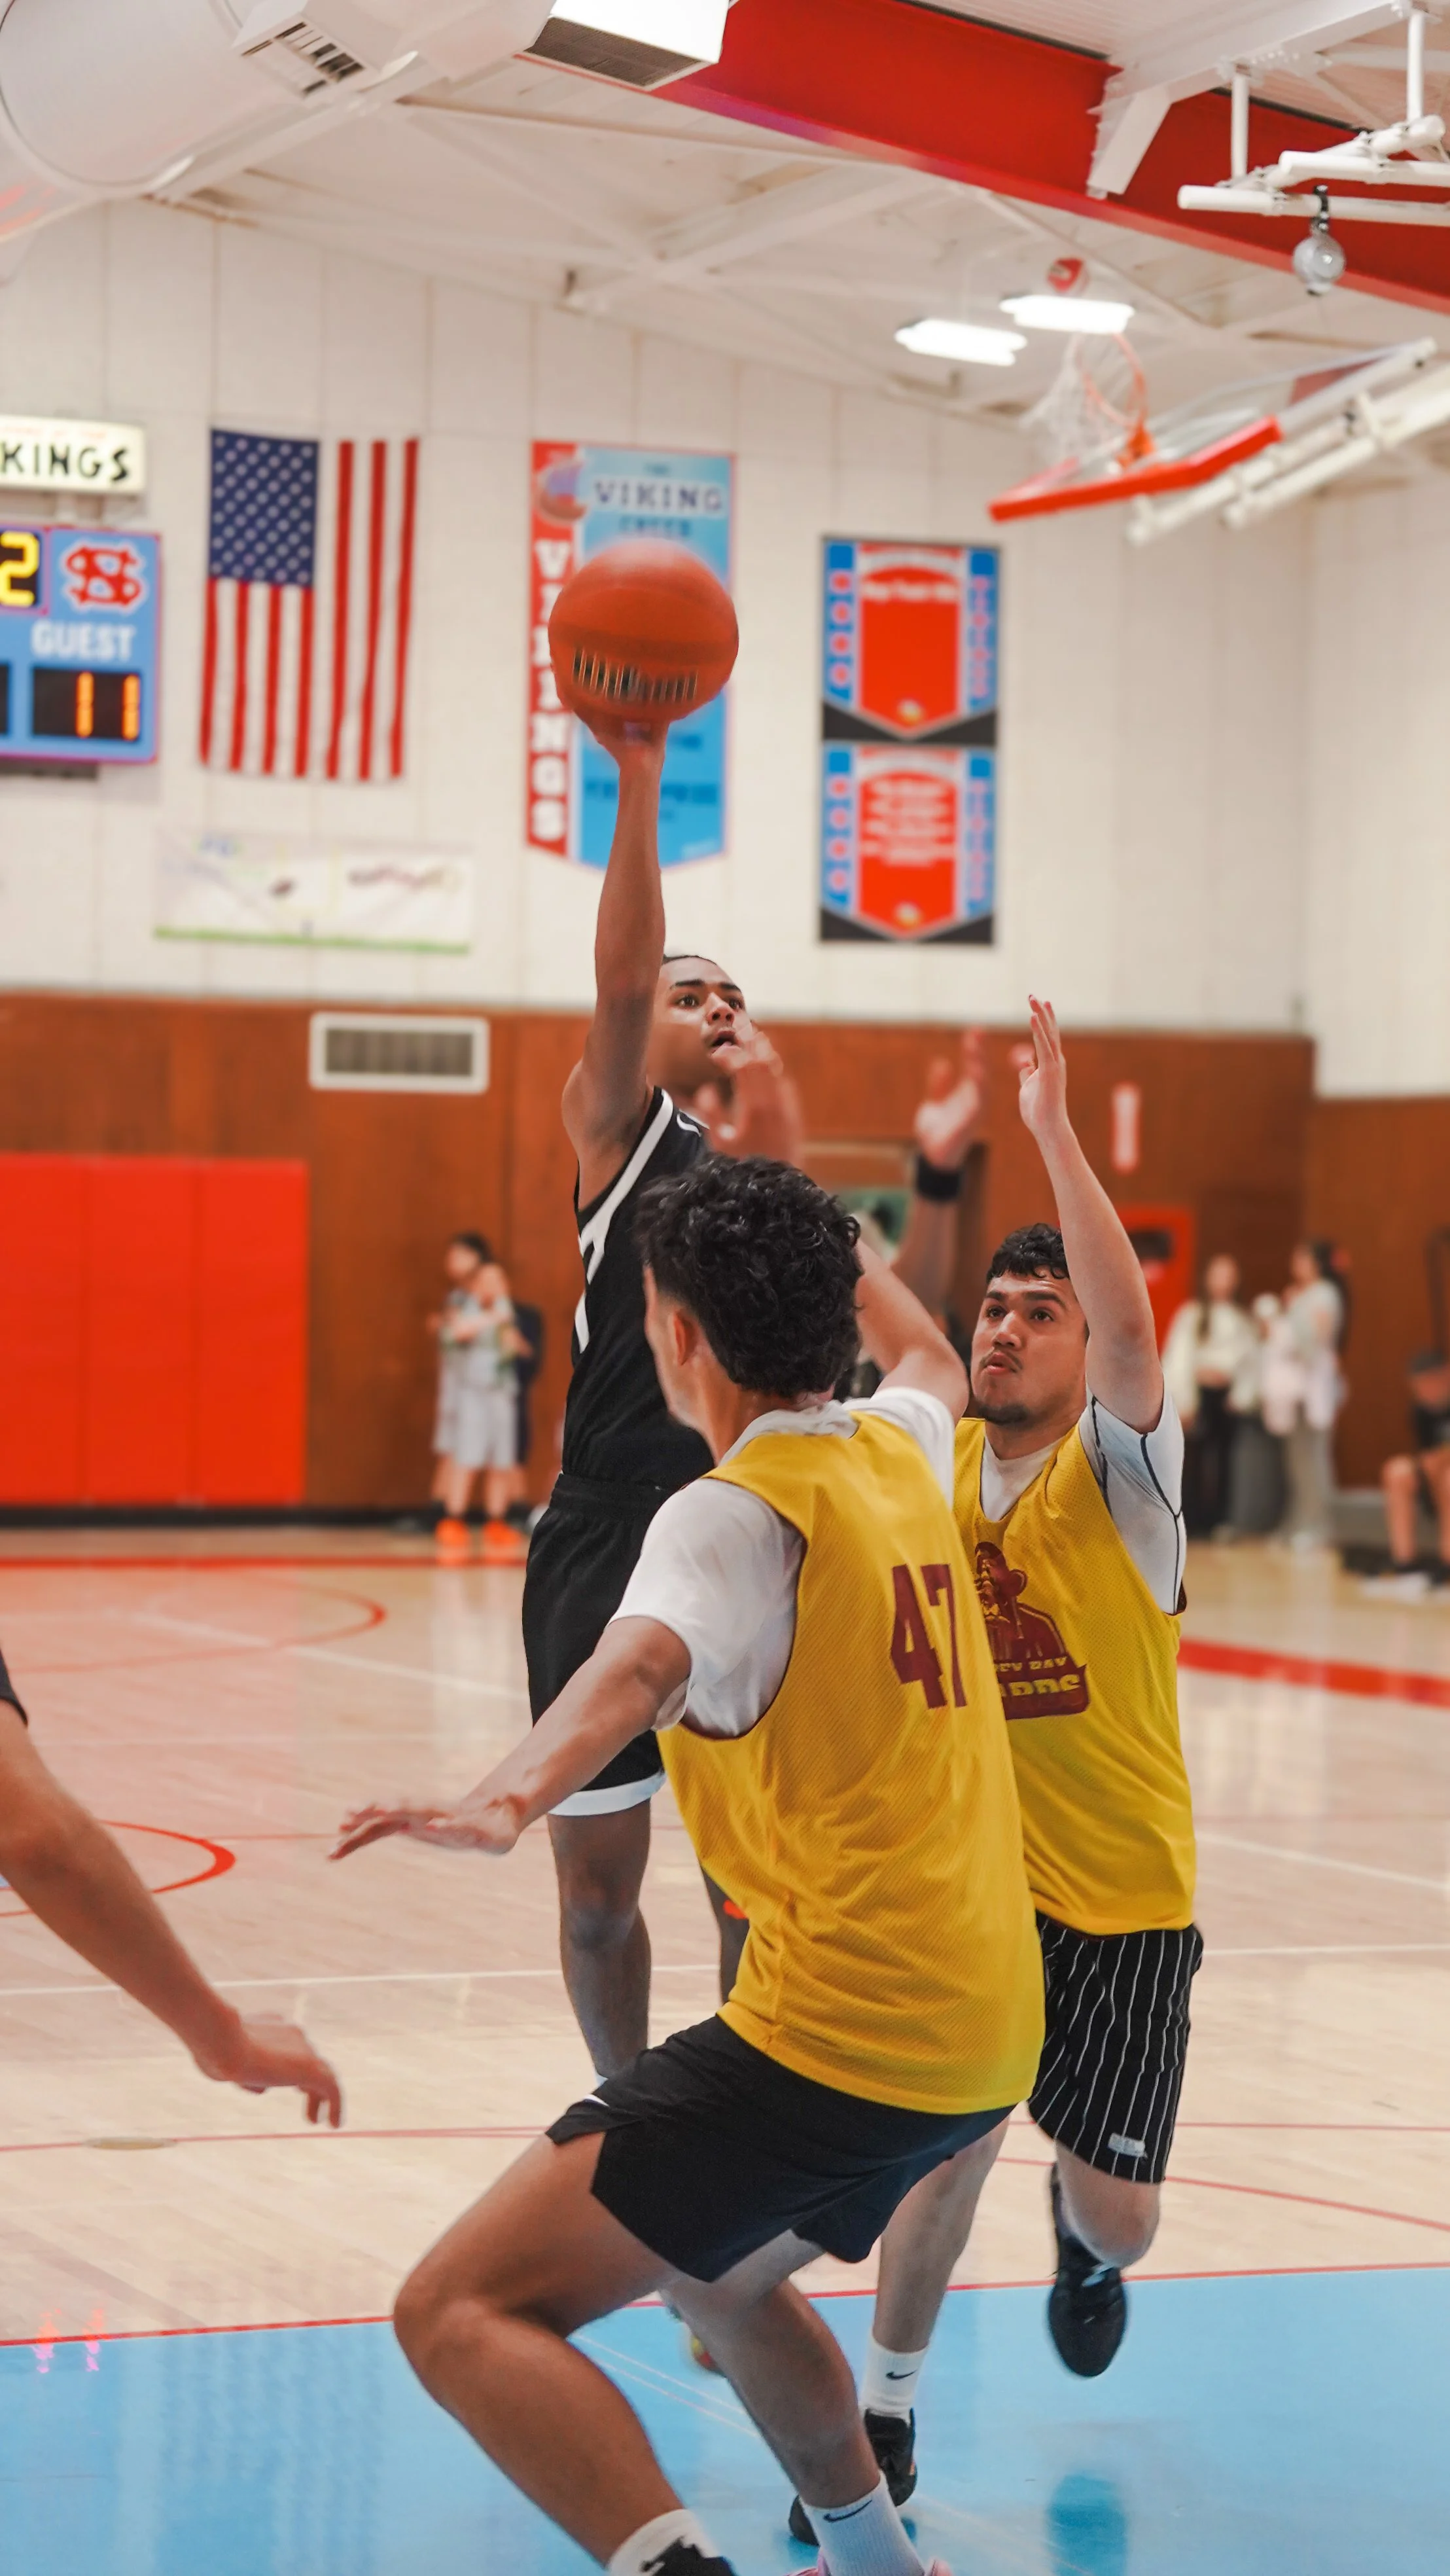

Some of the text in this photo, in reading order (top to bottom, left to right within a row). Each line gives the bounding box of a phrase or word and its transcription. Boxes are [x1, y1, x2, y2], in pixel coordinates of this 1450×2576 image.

[0, 441, 131, 483] KINGS
[595, 480, 722, 511] VIKING
[31, 618, 136, 660] GUEST
[76, 671, 140, 740] 11
[891, 1564, 967, 1709] 47
